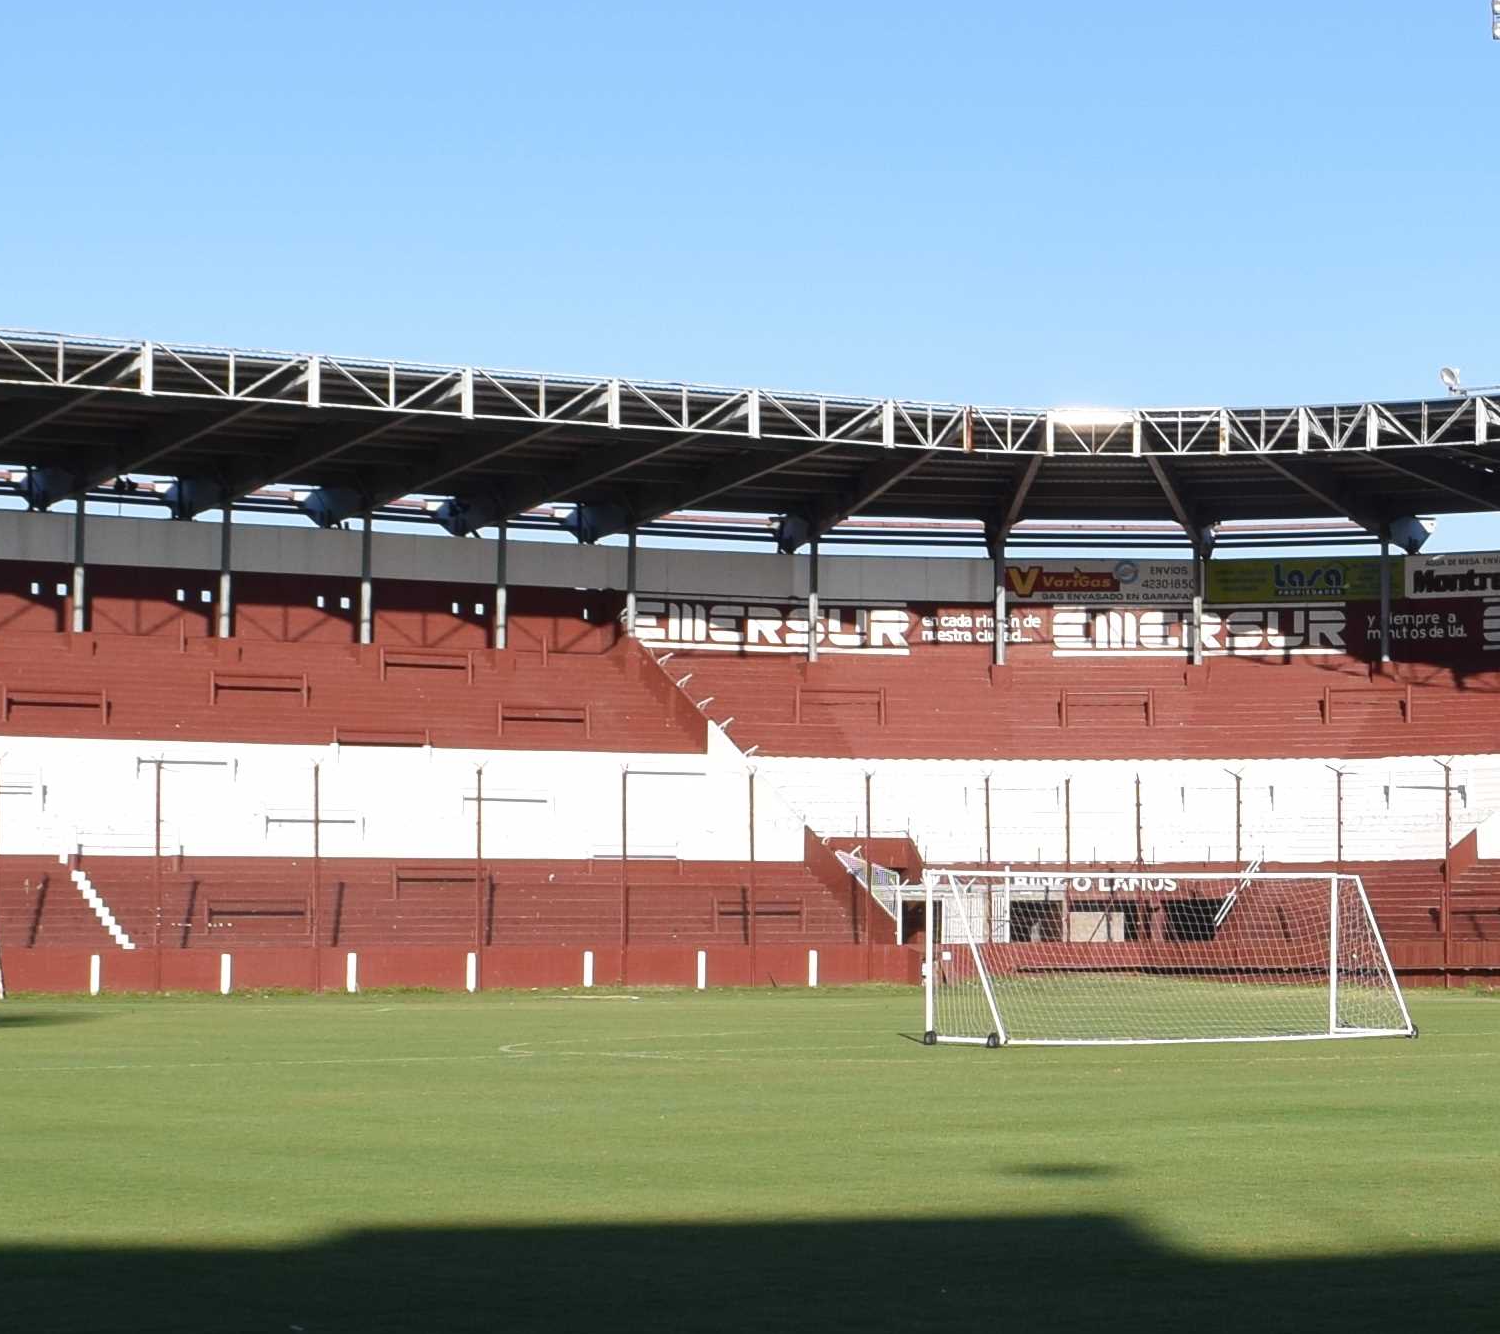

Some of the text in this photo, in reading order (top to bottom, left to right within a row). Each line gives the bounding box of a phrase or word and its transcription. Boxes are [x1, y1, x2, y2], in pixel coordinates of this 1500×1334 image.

[1043, 575, 1112, 588] VariGas
[940, 613, 972, 628] cada
[1023, 614, 1042, 628] de
[1367, 612, 1456, 628] y iempre a
[921, 629, 972, 642] nuestra
[1367, 624, 1427, 640] mnutos
[1429, 624, 1444, 638] de
